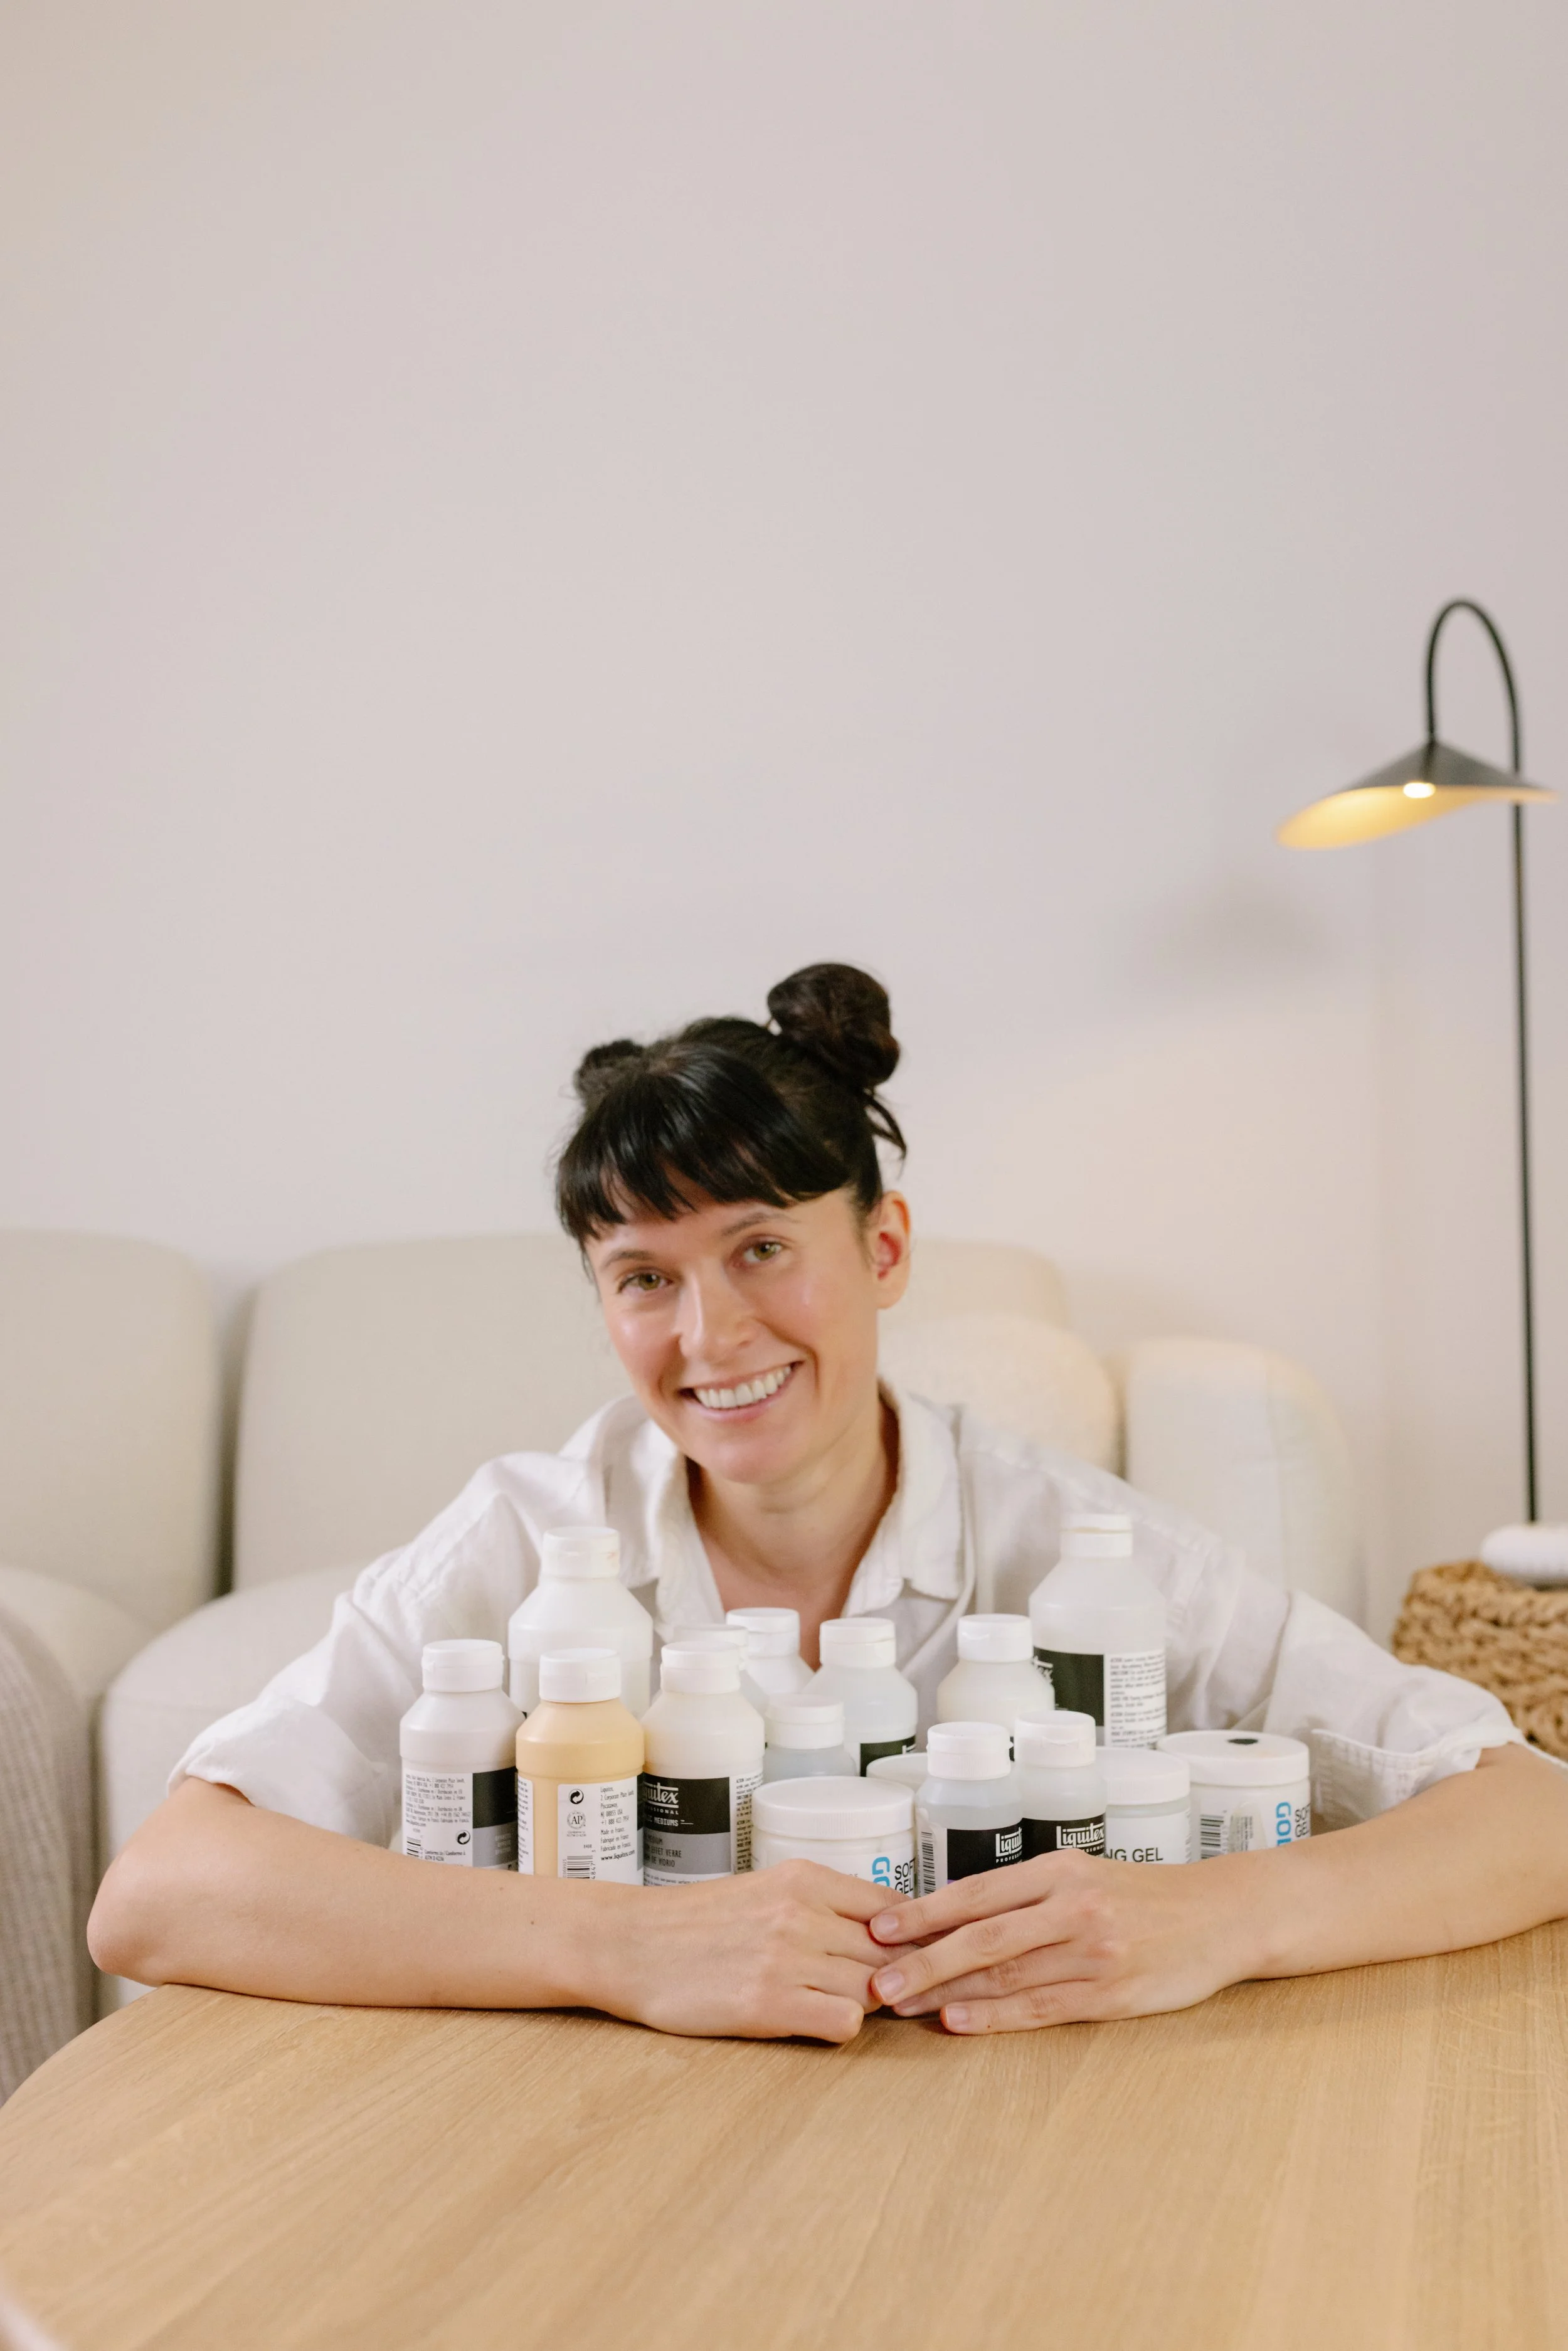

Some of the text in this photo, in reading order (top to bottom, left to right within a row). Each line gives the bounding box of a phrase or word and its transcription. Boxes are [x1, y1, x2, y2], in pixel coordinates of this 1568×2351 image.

[604, 1793, 620, 1802] Corporate
[571, 1815, 583, 1824] AP
[654, 1817, 679, 1827] MEDIUMS
[1056, 1823, 1104, 1850] Liquitex
[600, 1850, 635, 1860] www.liquitex.com
[665, 1849, 682, 1858] VERRE
[1132, 1848, 1163, 1863] GEL
